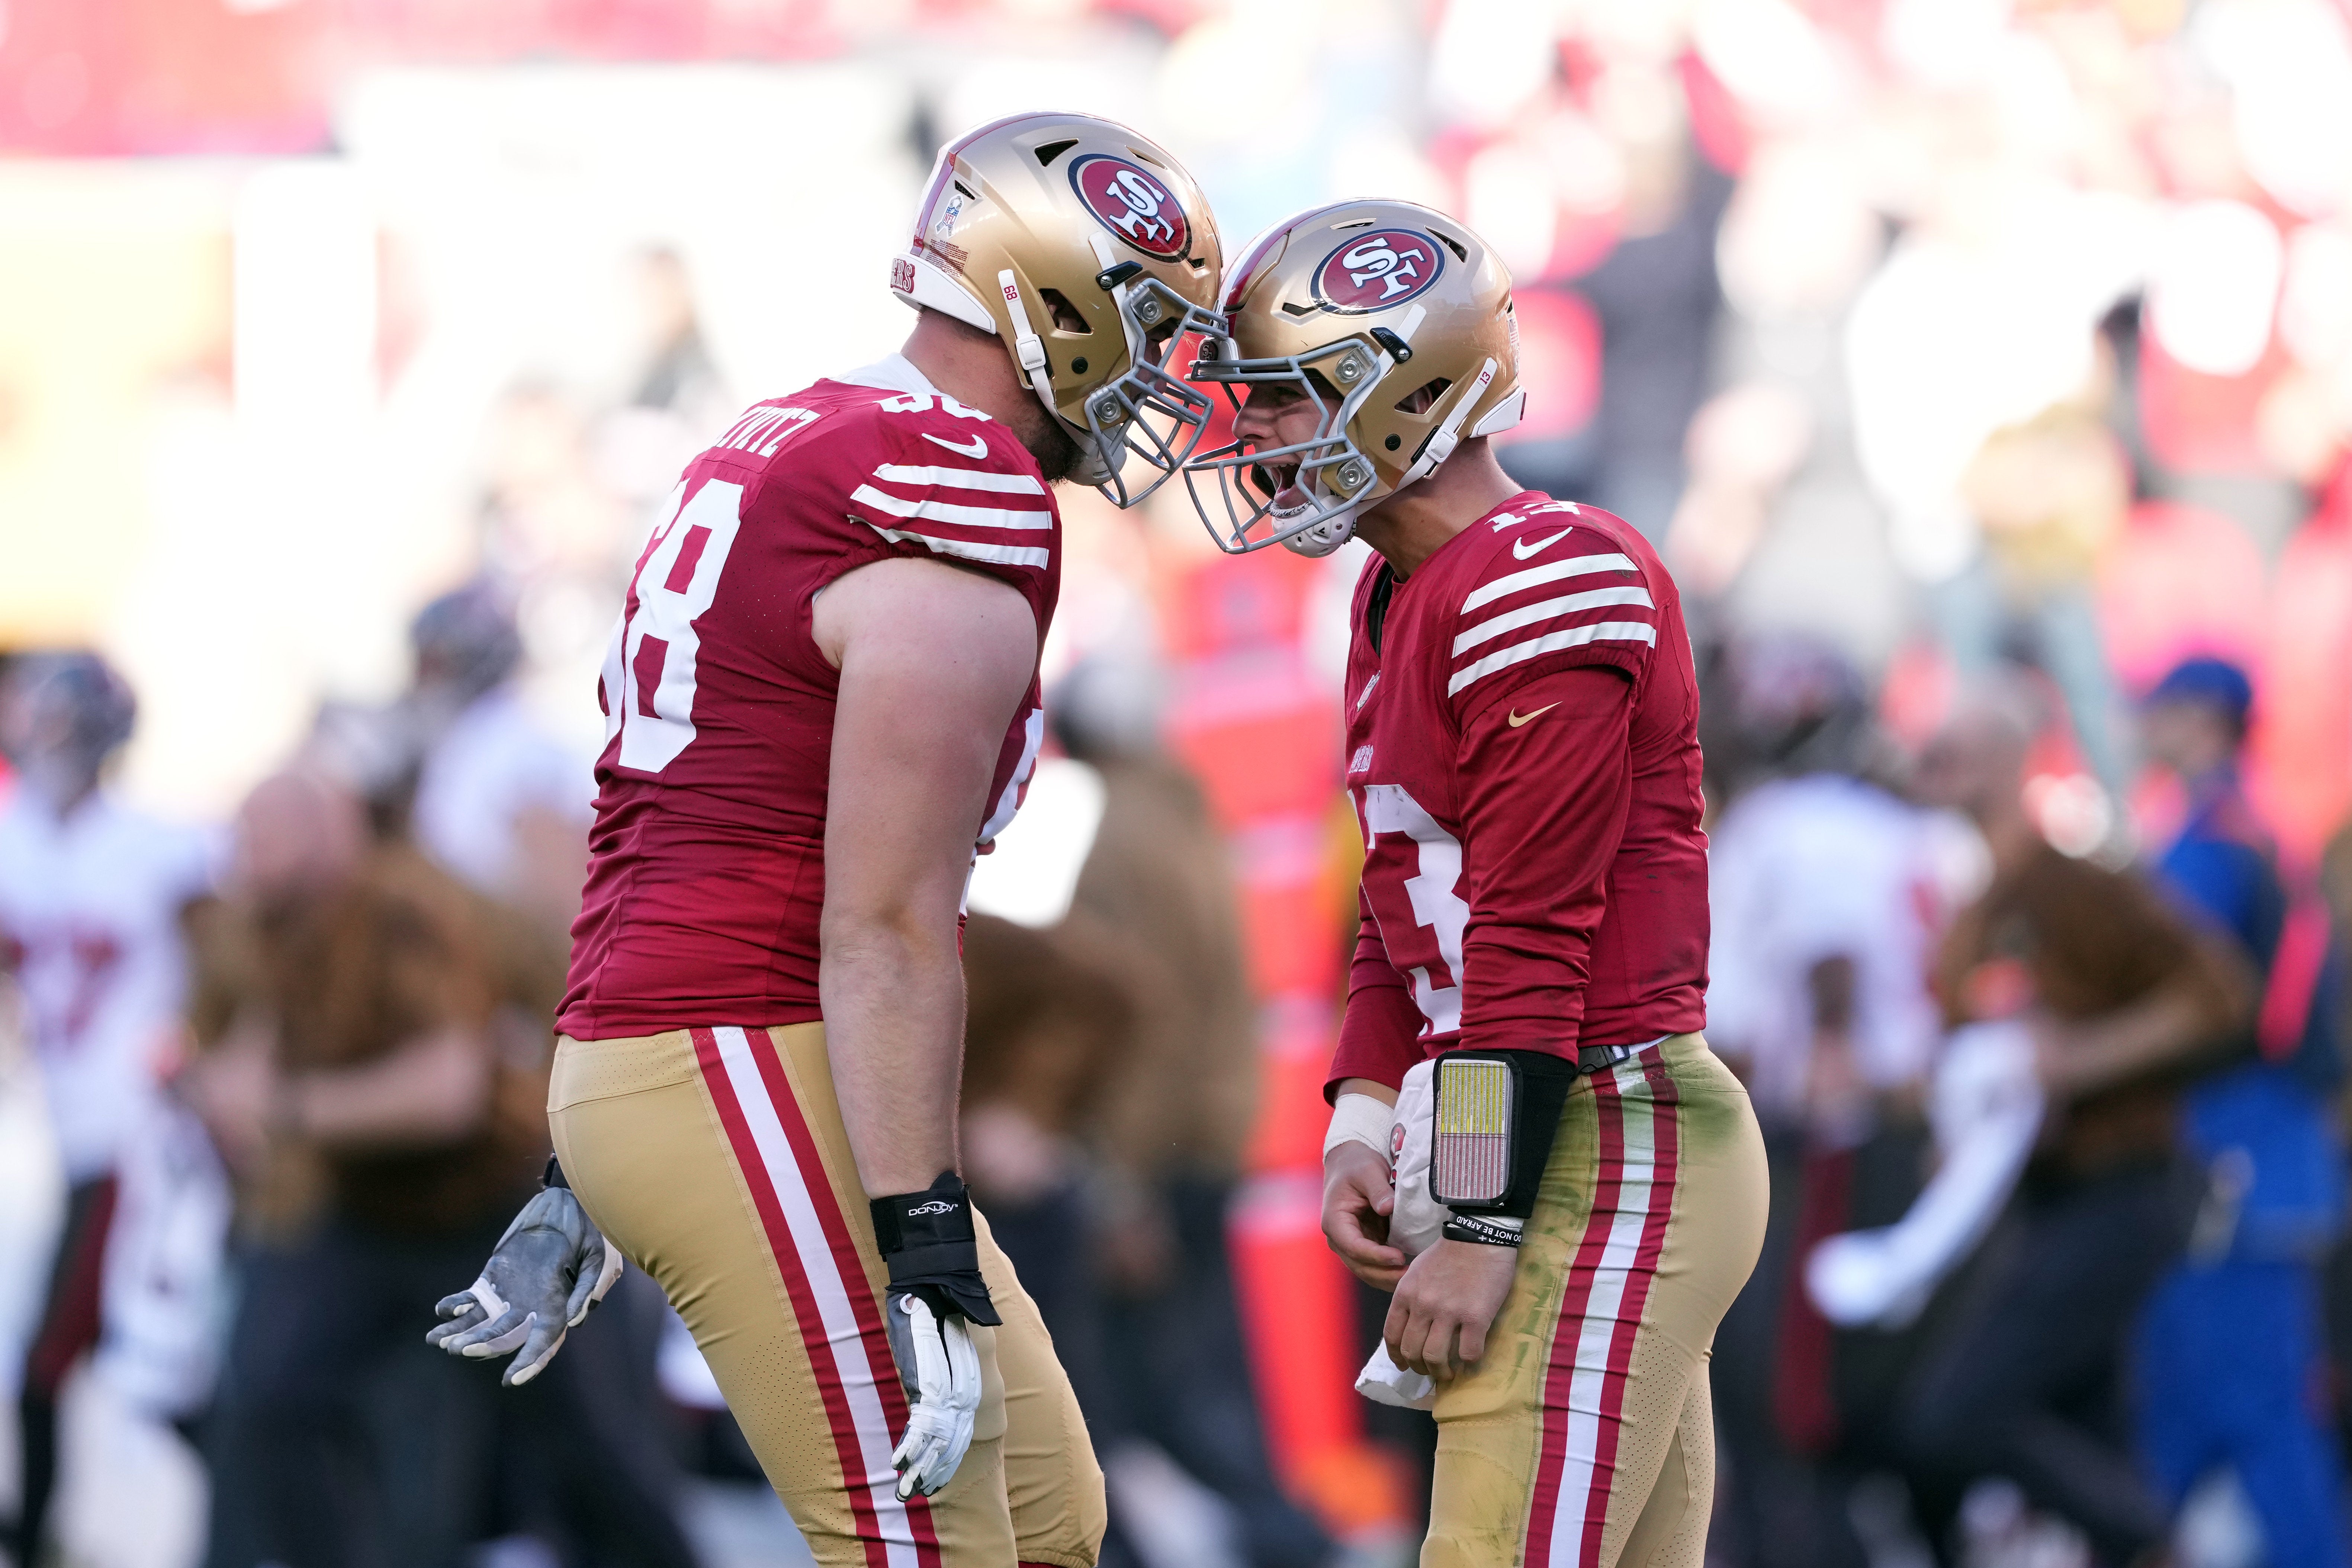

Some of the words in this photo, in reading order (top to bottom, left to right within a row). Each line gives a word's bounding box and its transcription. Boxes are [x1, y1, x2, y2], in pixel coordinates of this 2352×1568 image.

[943, 213, 954, 224] NFL
[939, 240, 959, 249] WARNING
[1004, 285, 1018, 300] 68
[1480, 371, 1491, 385] 13
[1456, 1216, 1482, 1230] AFRAID
[1483, 1226, 1494, 1235] BE
[1494, 1230, 1512, 1240] NOT
